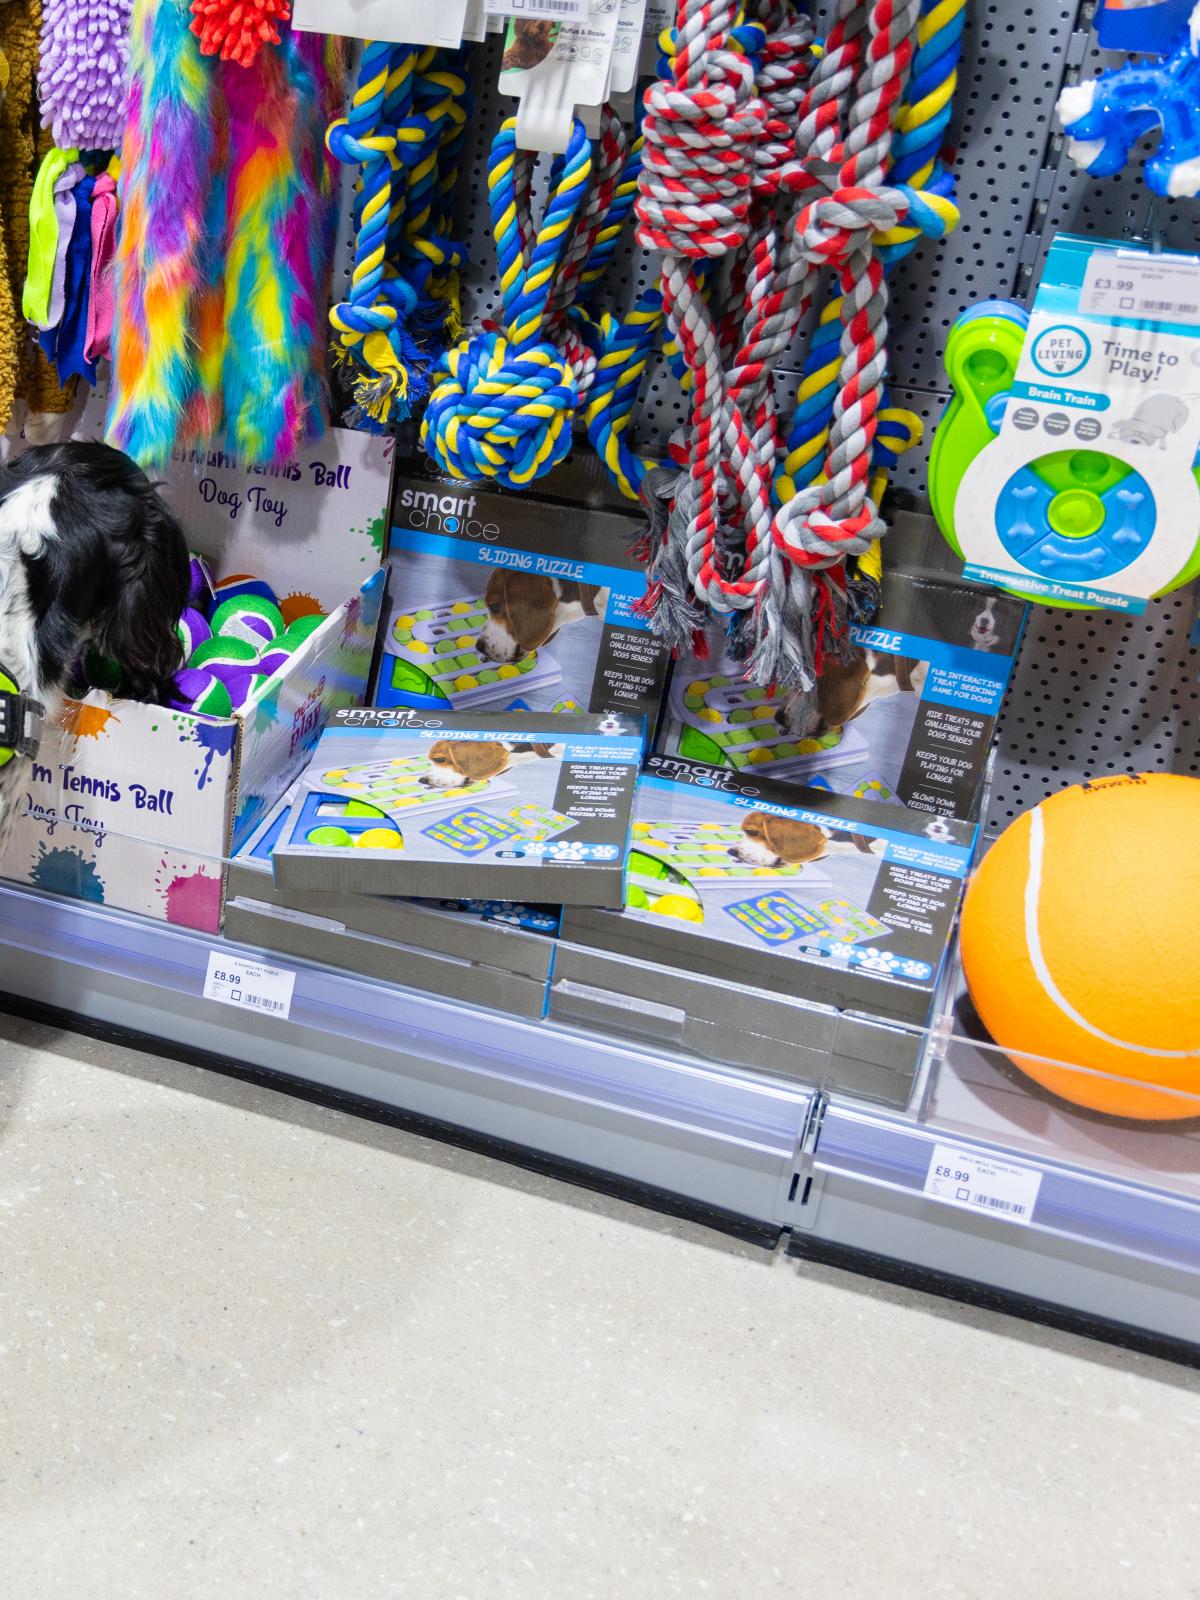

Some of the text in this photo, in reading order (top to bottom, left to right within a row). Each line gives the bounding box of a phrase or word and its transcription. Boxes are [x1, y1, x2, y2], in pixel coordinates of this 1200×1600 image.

[560, 27, 579, 35] Rufus
[1095, 279, 1133, 291] £3.99
[1050, 339, 1072, 348] PET
[1039, 348, 1083, 360] LIVING
[1103, 340, 1179, 366] Time to
[1109, 359, 1162, 383] Play!
[1028, 387, 1096, 406] Brain Train
[309, 461, 351, 490] Ball
[199, 478, 288, 527] Dog Toy
[401, 489, 476, 518] smart
[409, 507, 500, 541] choice
[478, 547, 584, 579] SLIDING PUZZLE
[612, 593, 625, 601] FUN
[979, 571, 1129, 608] Interactive Treat Puzzle
[611, 632, 625, 641] HIDE
[627, 634, 649, 645] TREATS
[848, 627, 903, 650] PUZZLE
[610, 640, 660, 656] CHALLENGE YOUR
[613, 651, 653, 663] DOGS SENSES
[604, 670, 655, 686] KEEPS YOUR DOG
[608, 679, 647, 693] PLAYING FOR
[931, 668, 1002, 689] FUN INTERACTIVE
[933, 677, 997, 696] TREAT SEEKING
[614, 690, 638, 700] LONGER
[931, 685, 993, 705] GAME FOR DOGS
[336, 709, 417, 720] smart
[344, 715, 443, 728] choice
[927, 710, 984, 729] HIDE TREATS AND
[420, 730, 535, 741] SLIDING PUZZLE
[925, 719, 981, 738] CHALLENGE YOUR
[928, 729, 973, 746] DOGS SENSES
[916, 750, 973, 769] KEEPS YOUR DOG
[648, 757, 734, 781] smart
[920, 761, 964, 777] PLAYING FOR
[655, 769, 760, 797] choice
[926, 772, 953, 784] LONGER
[59, 763, 121, 802] Tennis
[129, 784, 173, 815] Ball
[912, 792, 955, 808] SLOWS DOWN
[734, 797, 857, 831] SLIDING PUZZLE
[907, 801, 955, 818] FEEDING TIME
[65, 804, 107, 848] Toy
[214, 970, 240, 984] £8.99
[936, 1165, 969, 1182] £8.99
[977, 1167, 996, 1176] EACH
